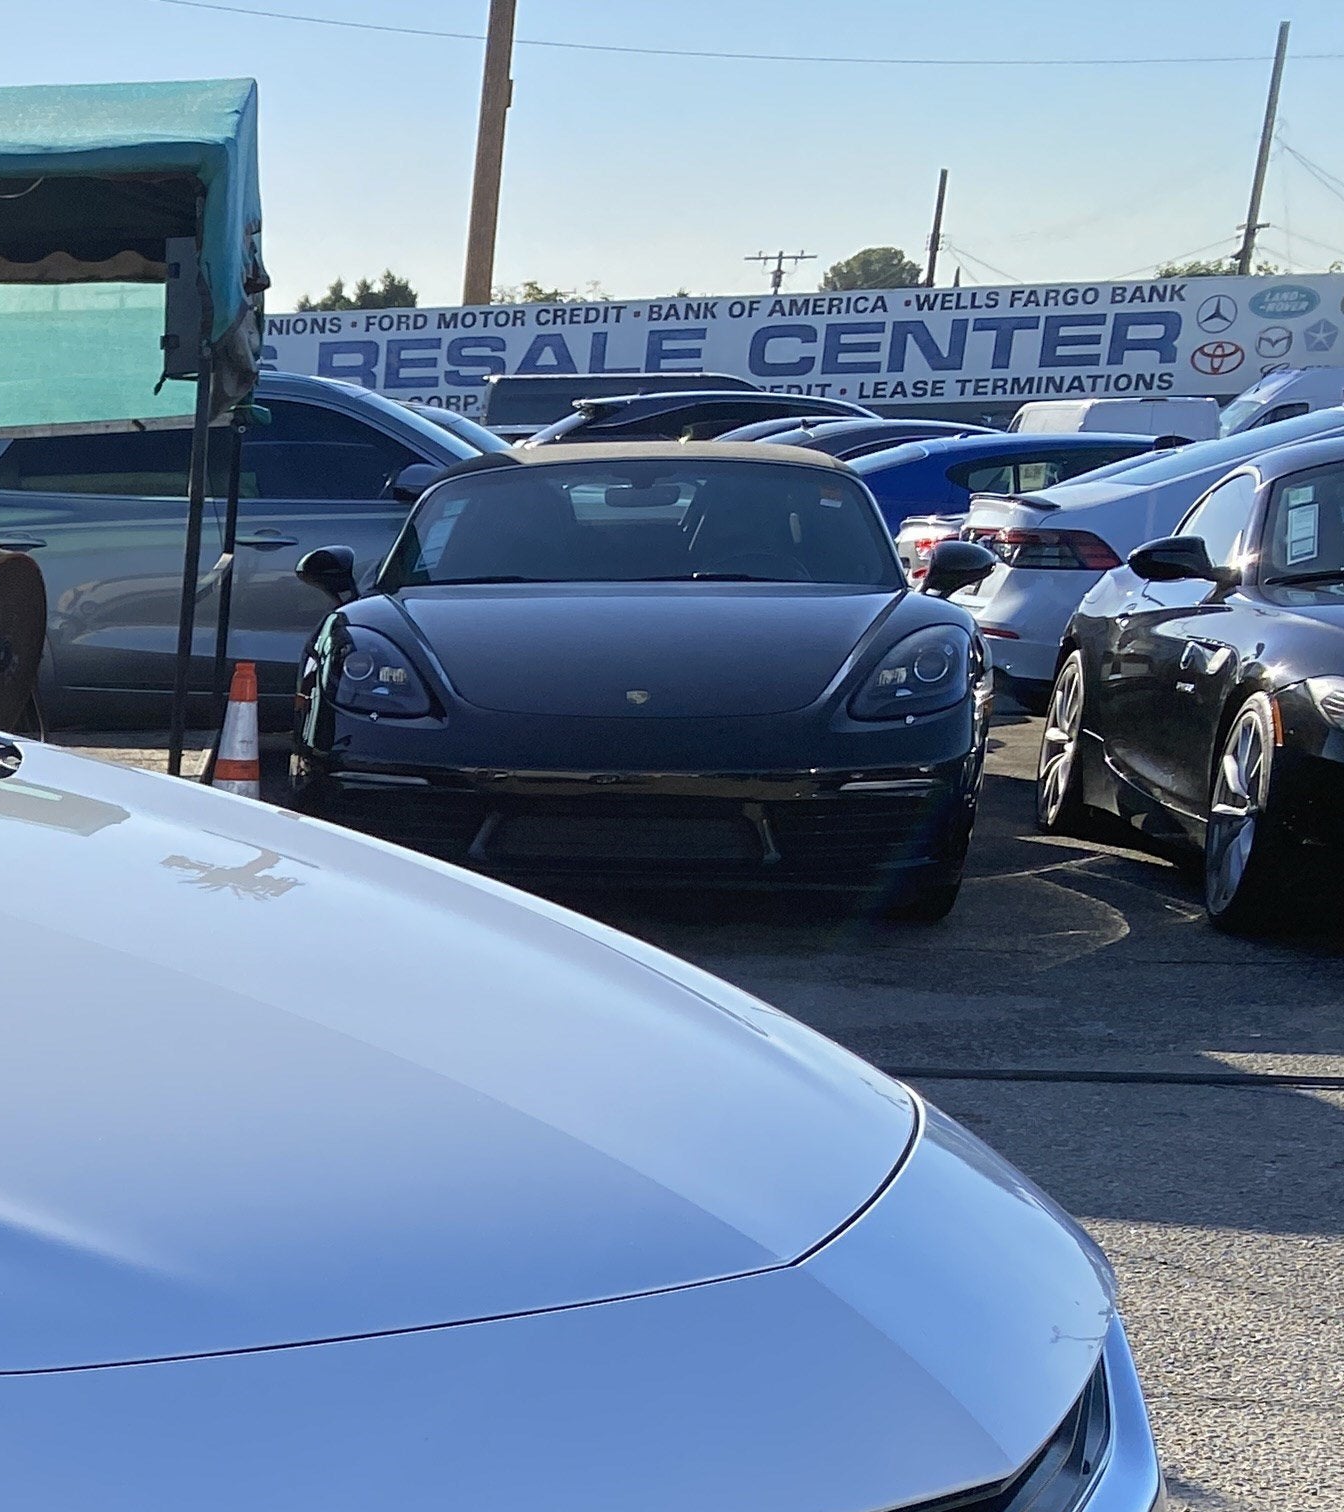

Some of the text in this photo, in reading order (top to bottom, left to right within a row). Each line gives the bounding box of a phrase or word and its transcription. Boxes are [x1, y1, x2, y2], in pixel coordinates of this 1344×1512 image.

[262, 283, 1188, 336] NIONS FORD MOTOR CREDIT BANK OF AMERICA WELLS FARGO BANK
[317, 327, 708, 389] RESALE
[748, 310, 1183, 377] CENTER
[858, 379, 946, 399] LEASE
[955, 371, 1175, 397] TERMINATIONS
